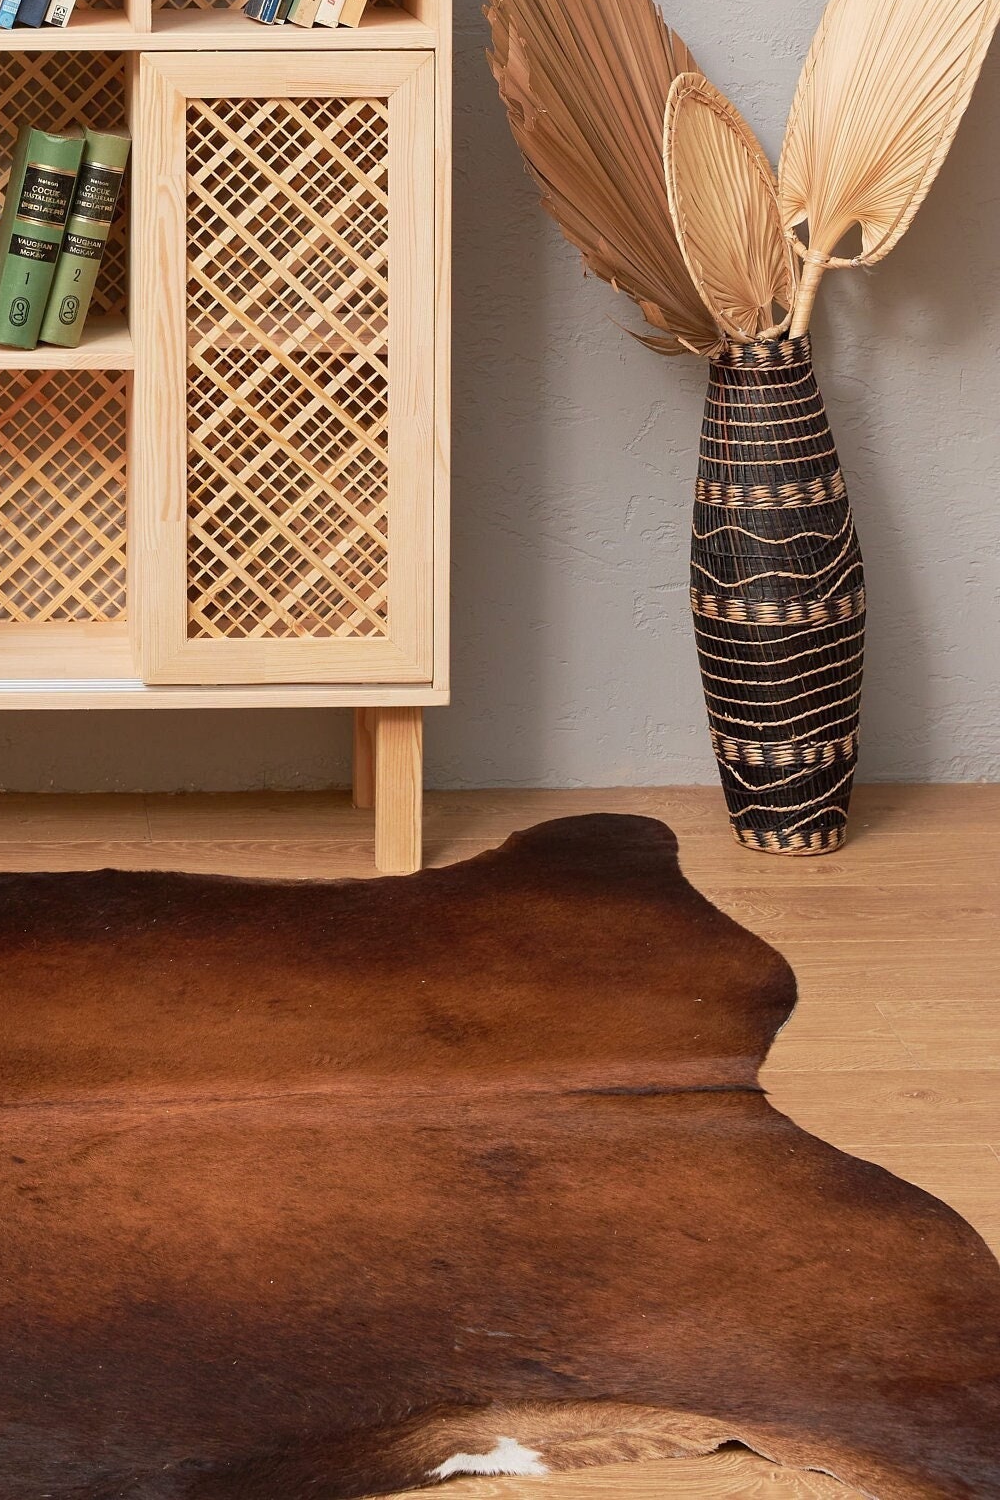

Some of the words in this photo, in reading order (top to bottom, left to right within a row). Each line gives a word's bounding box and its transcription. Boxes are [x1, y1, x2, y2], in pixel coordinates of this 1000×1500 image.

[38, 178, 59, 187] Nelson
[91, 178, 109, 186] Nelson
[32, 185, 60, 197] ÇOCUK
[85, 185, 111, 195] ÇOCUK
[18, 238, 53, 250] VAUGHAN
[68, 235, 101, 248] VAUGHAN
[20, 249, 45, 259] McKAY
[69, 247, 95, 256] McKAY
[25, 272, 30, 285] 1
[74, 269, 81, 282] 2
